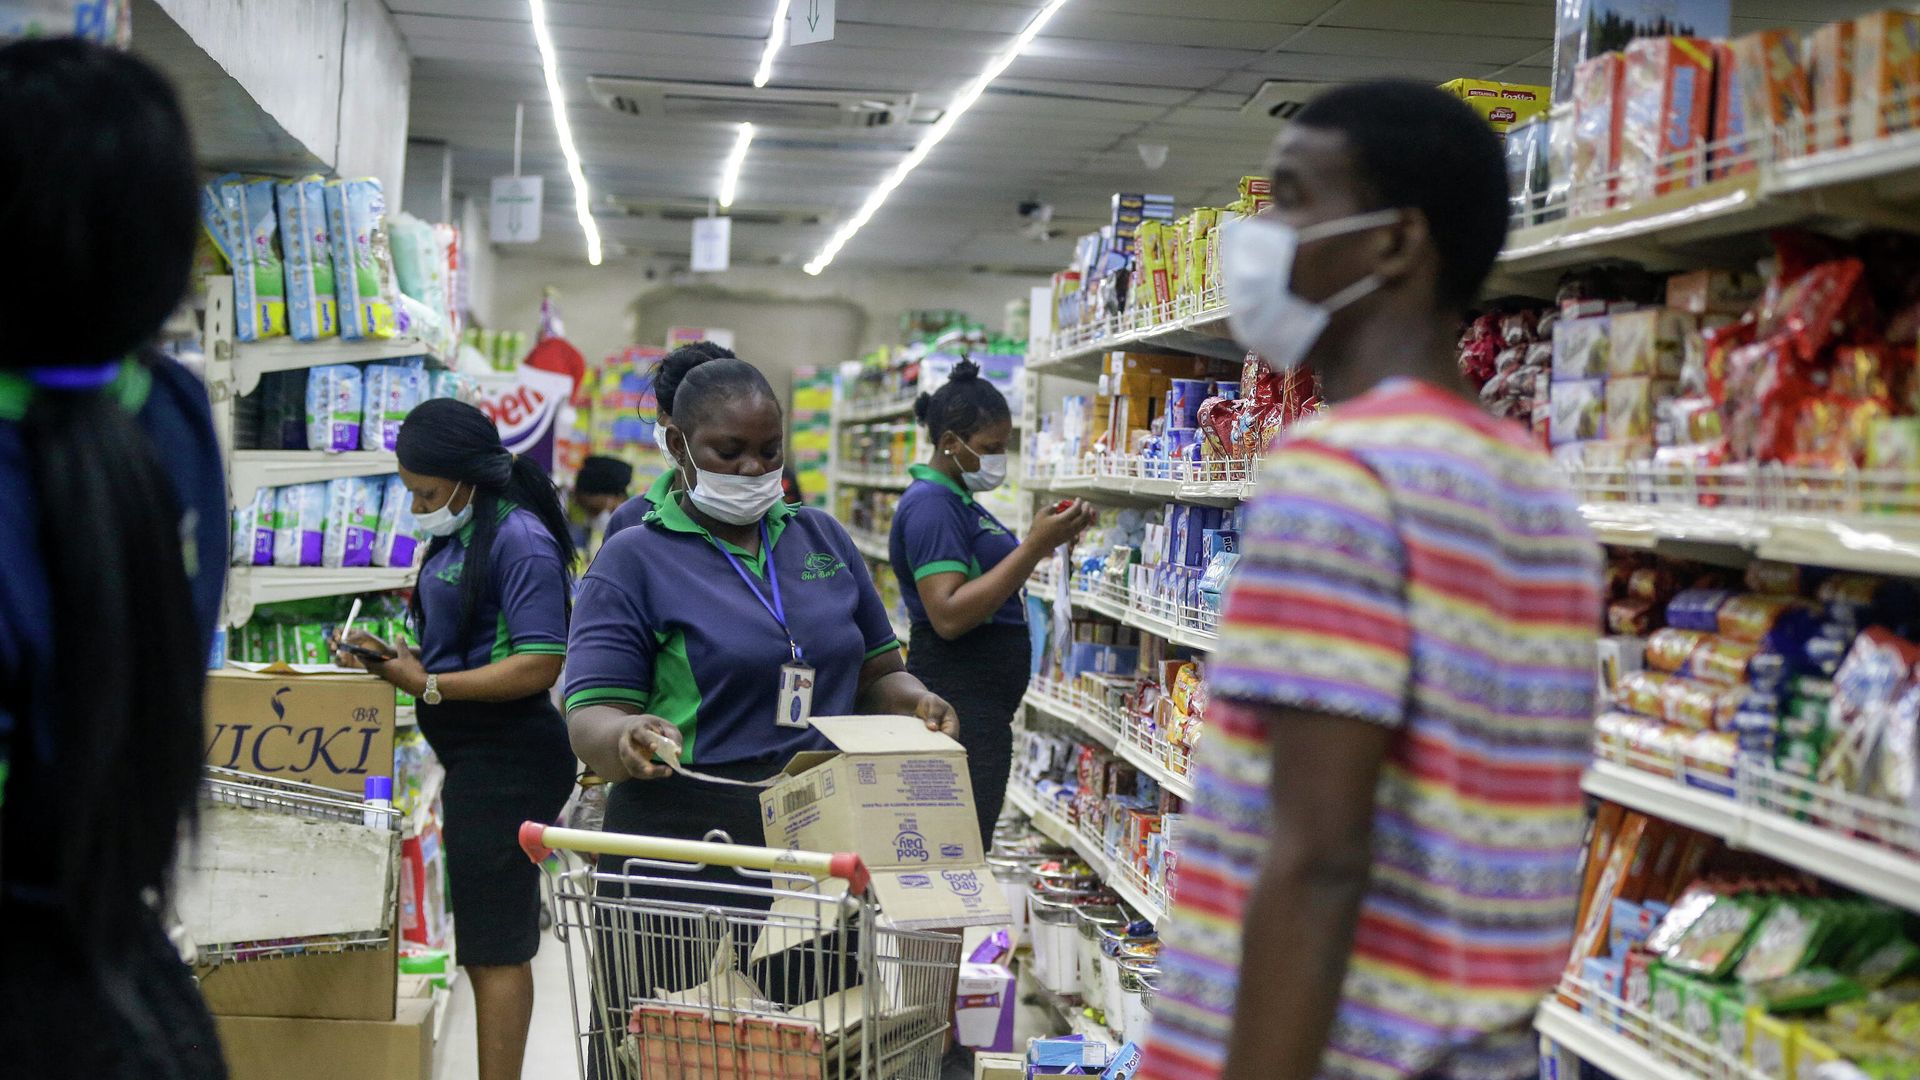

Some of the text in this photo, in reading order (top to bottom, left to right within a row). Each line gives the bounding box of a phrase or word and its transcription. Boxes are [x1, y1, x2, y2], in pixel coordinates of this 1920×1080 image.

[352, 707, 381, 725] BR
[899, 837, 923, 851] Day
[896, 849, 929, 863] Good
[942, 869, 977, 881] Good
[950, 881, 977, 891] Day
